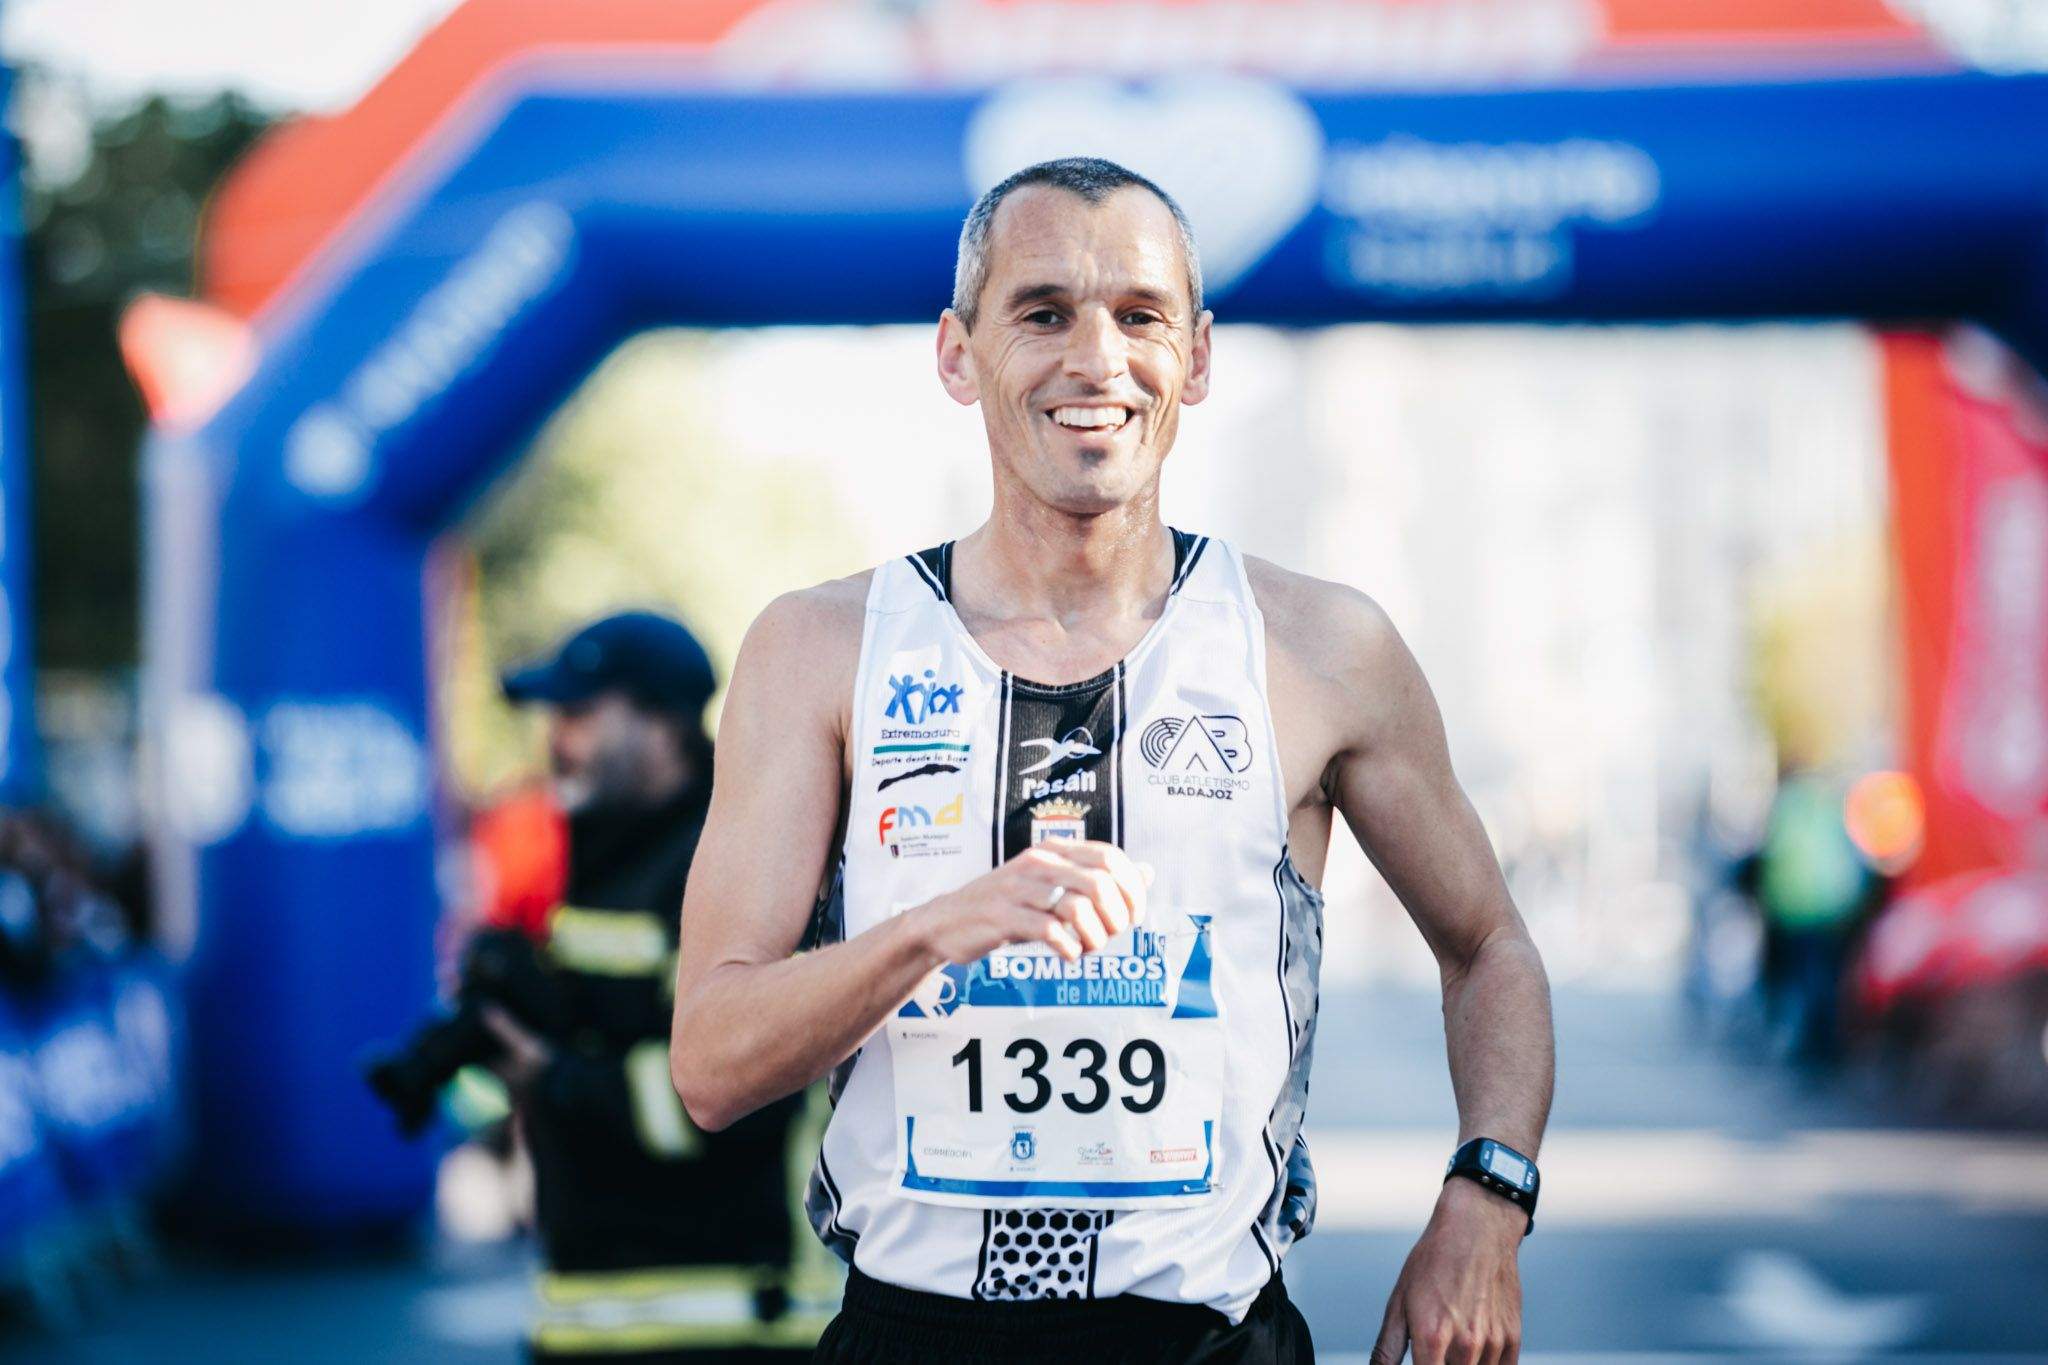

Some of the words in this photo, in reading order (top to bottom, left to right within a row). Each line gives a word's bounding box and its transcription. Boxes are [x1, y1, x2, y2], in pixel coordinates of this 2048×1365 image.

[881, 729, 960, 739] Extremadura
[1147, 774, 1180, 786] CLUB
[1183, 775, 1250, 791] ATLETISMO
[1167, 786, 1233, 800] BADAJOZ
[989, 955, 1165, 980] BOMBEROS
[1056, 980, 1081, 1005] de
[1087, 980, 1165, 1005] MADRID
[952, 1038, 1167, 1114] 1339
